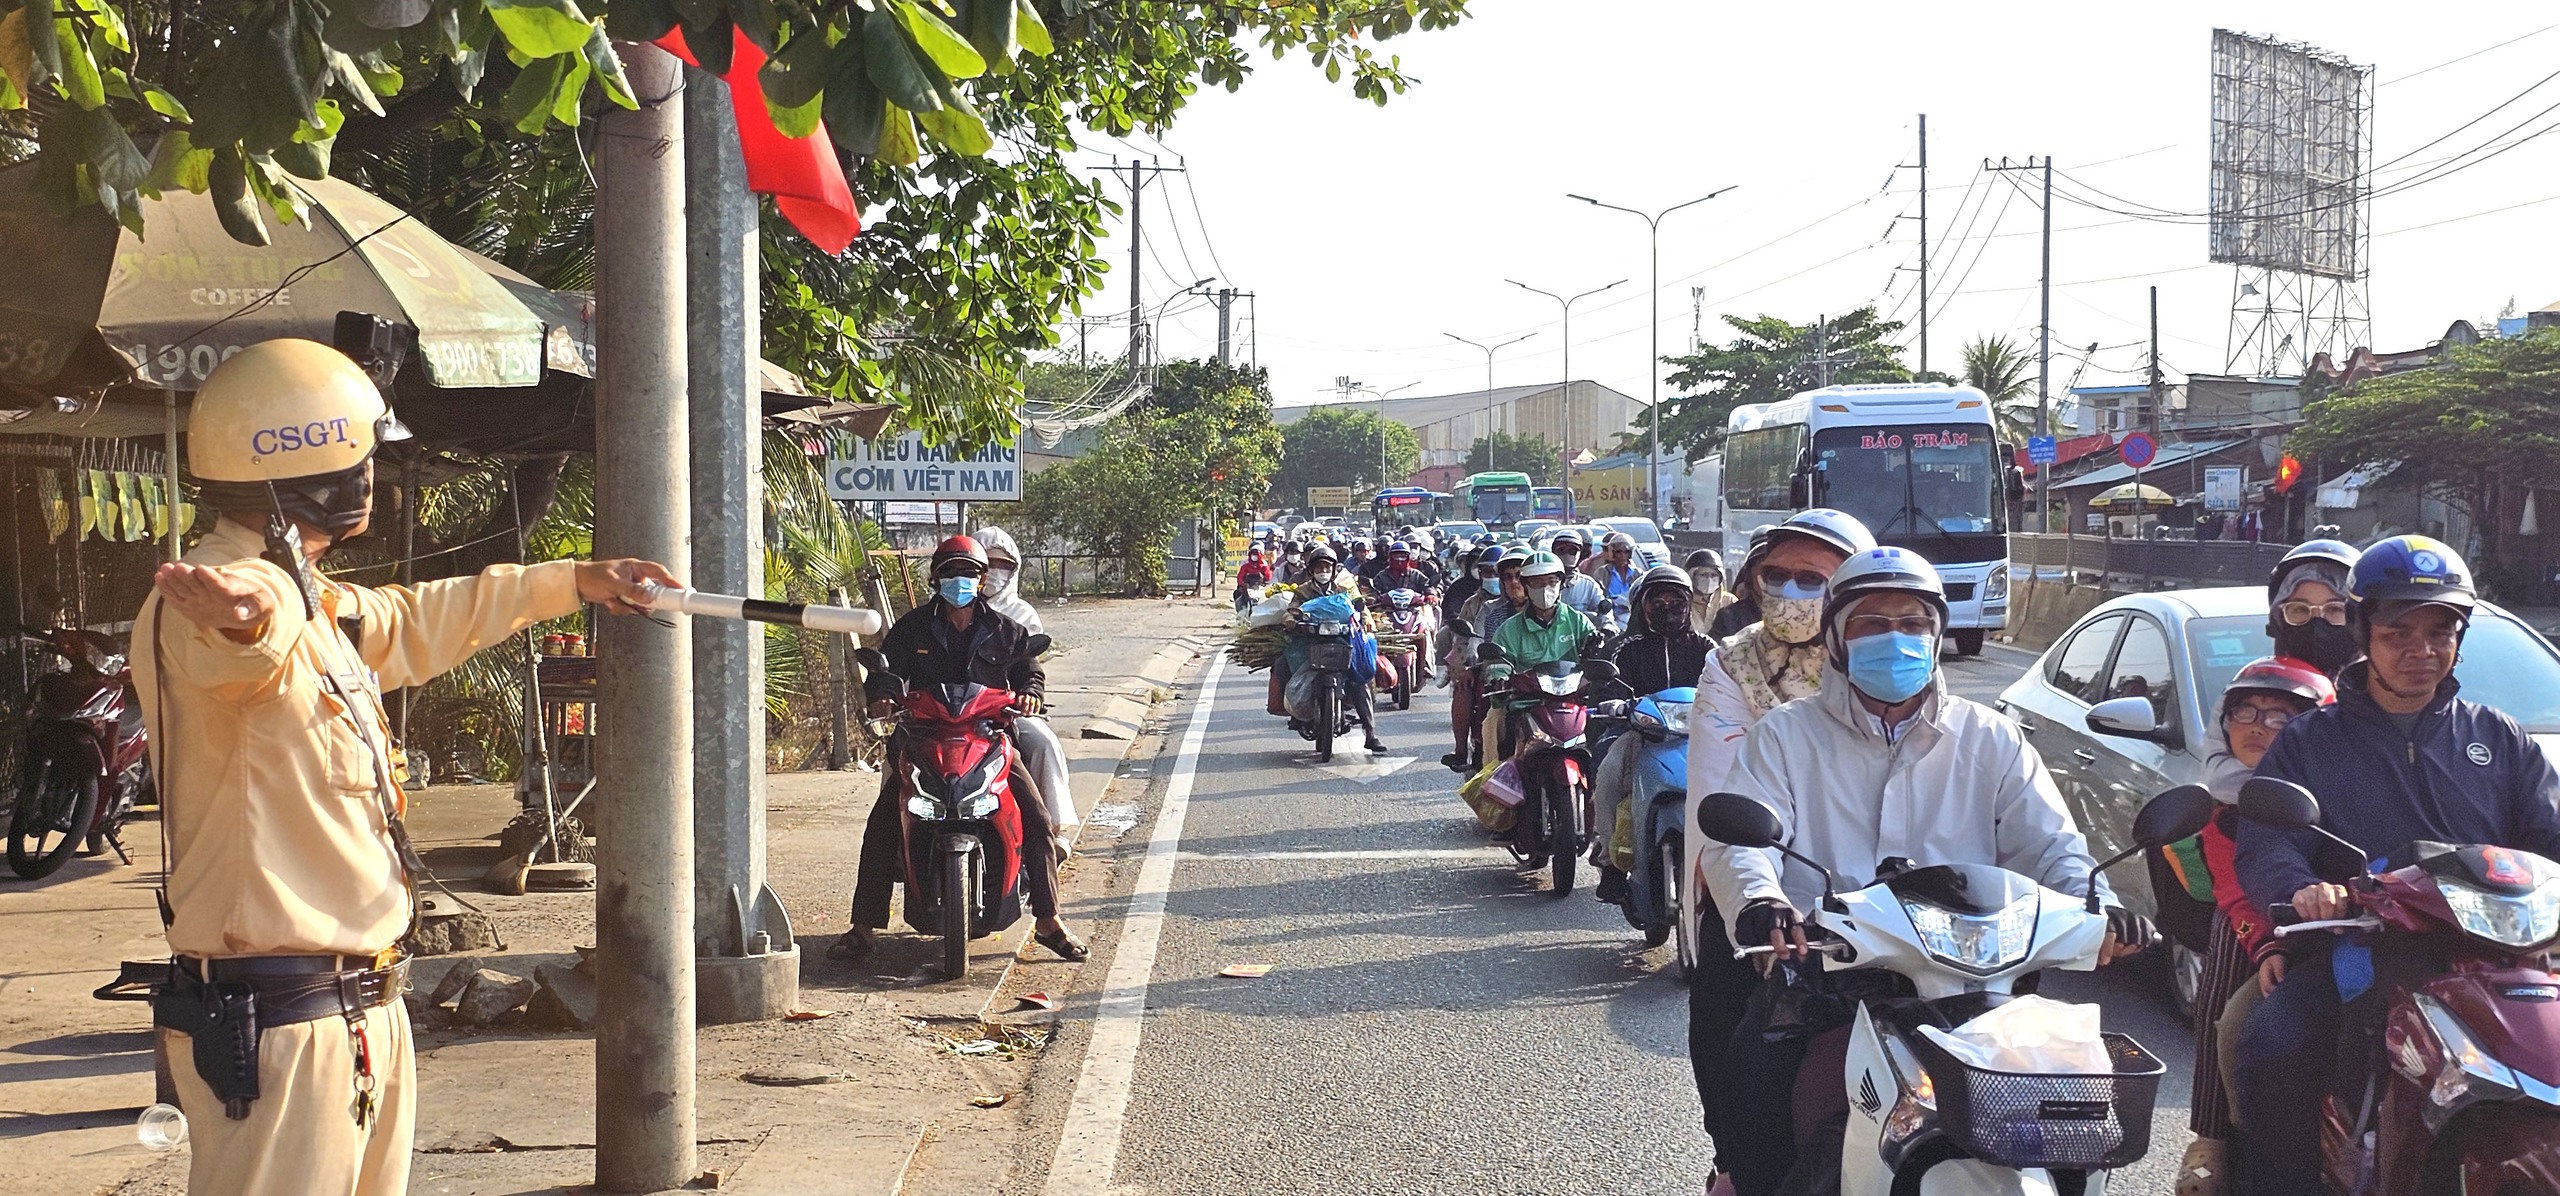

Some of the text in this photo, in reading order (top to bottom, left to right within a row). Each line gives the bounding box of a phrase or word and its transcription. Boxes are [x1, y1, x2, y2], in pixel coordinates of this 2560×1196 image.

[191, 288, 291, 305] COFFEE
[252, 417, 349, 455] CSGT
[1861, 429, 1968, 449] BẢO TRÂM
[835, 464, 1013, 495] CƠM VIỆT NAM
